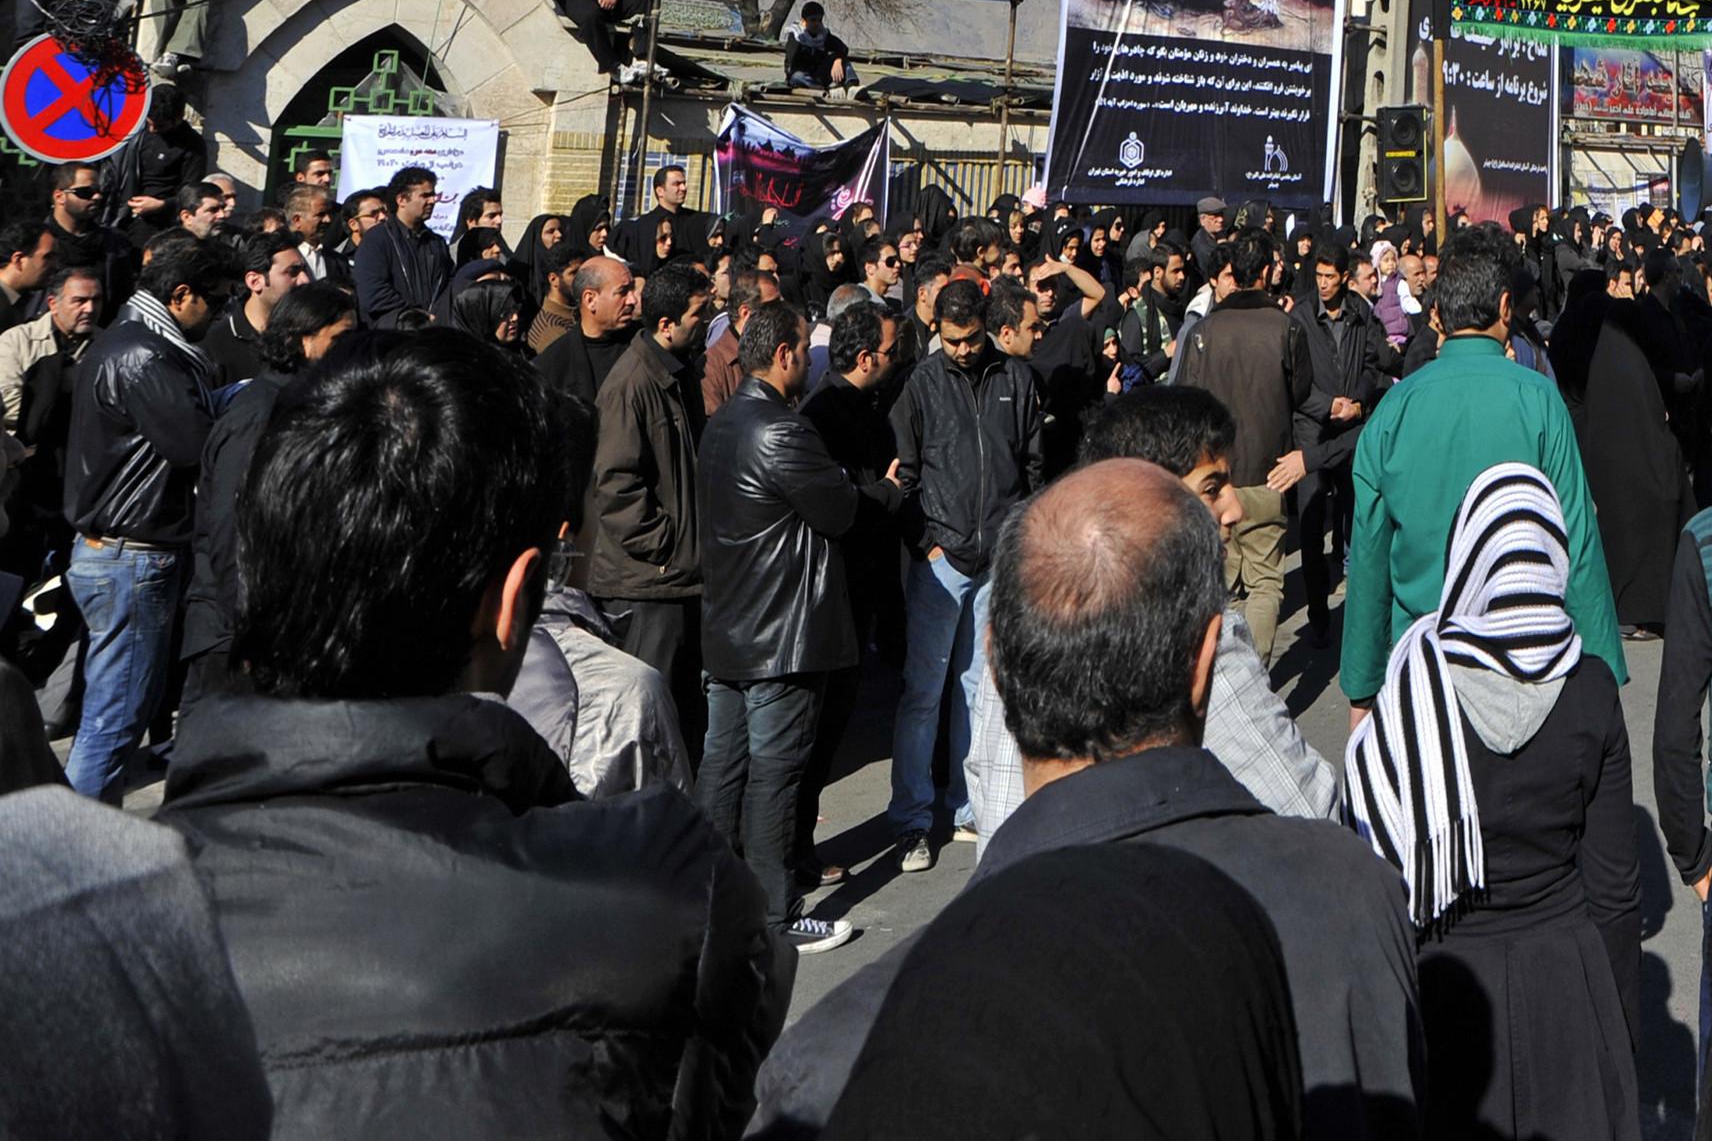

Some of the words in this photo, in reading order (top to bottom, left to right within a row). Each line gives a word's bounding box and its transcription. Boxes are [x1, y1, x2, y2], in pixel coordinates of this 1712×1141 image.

[1092, 40, 1099, 53] را
[1229, 52, 1251, 66] دختران
[1147, 75, 1152, 83] و
[1172, 74, 1194, 83] شناخته
[1225, 77, 1240, 90] برای
[1495, 72, 1505, 98] از
[1505, 74, 1526, 102] برنامه
[1527, 80, 1548, 106] شروع
[1174, 99, 1197, 112] مهربان
[1198, 104, 1202, 113] و
[1230, 103, 1251, 116] خداوند
[1298, 109, 1310, 122] قرار
